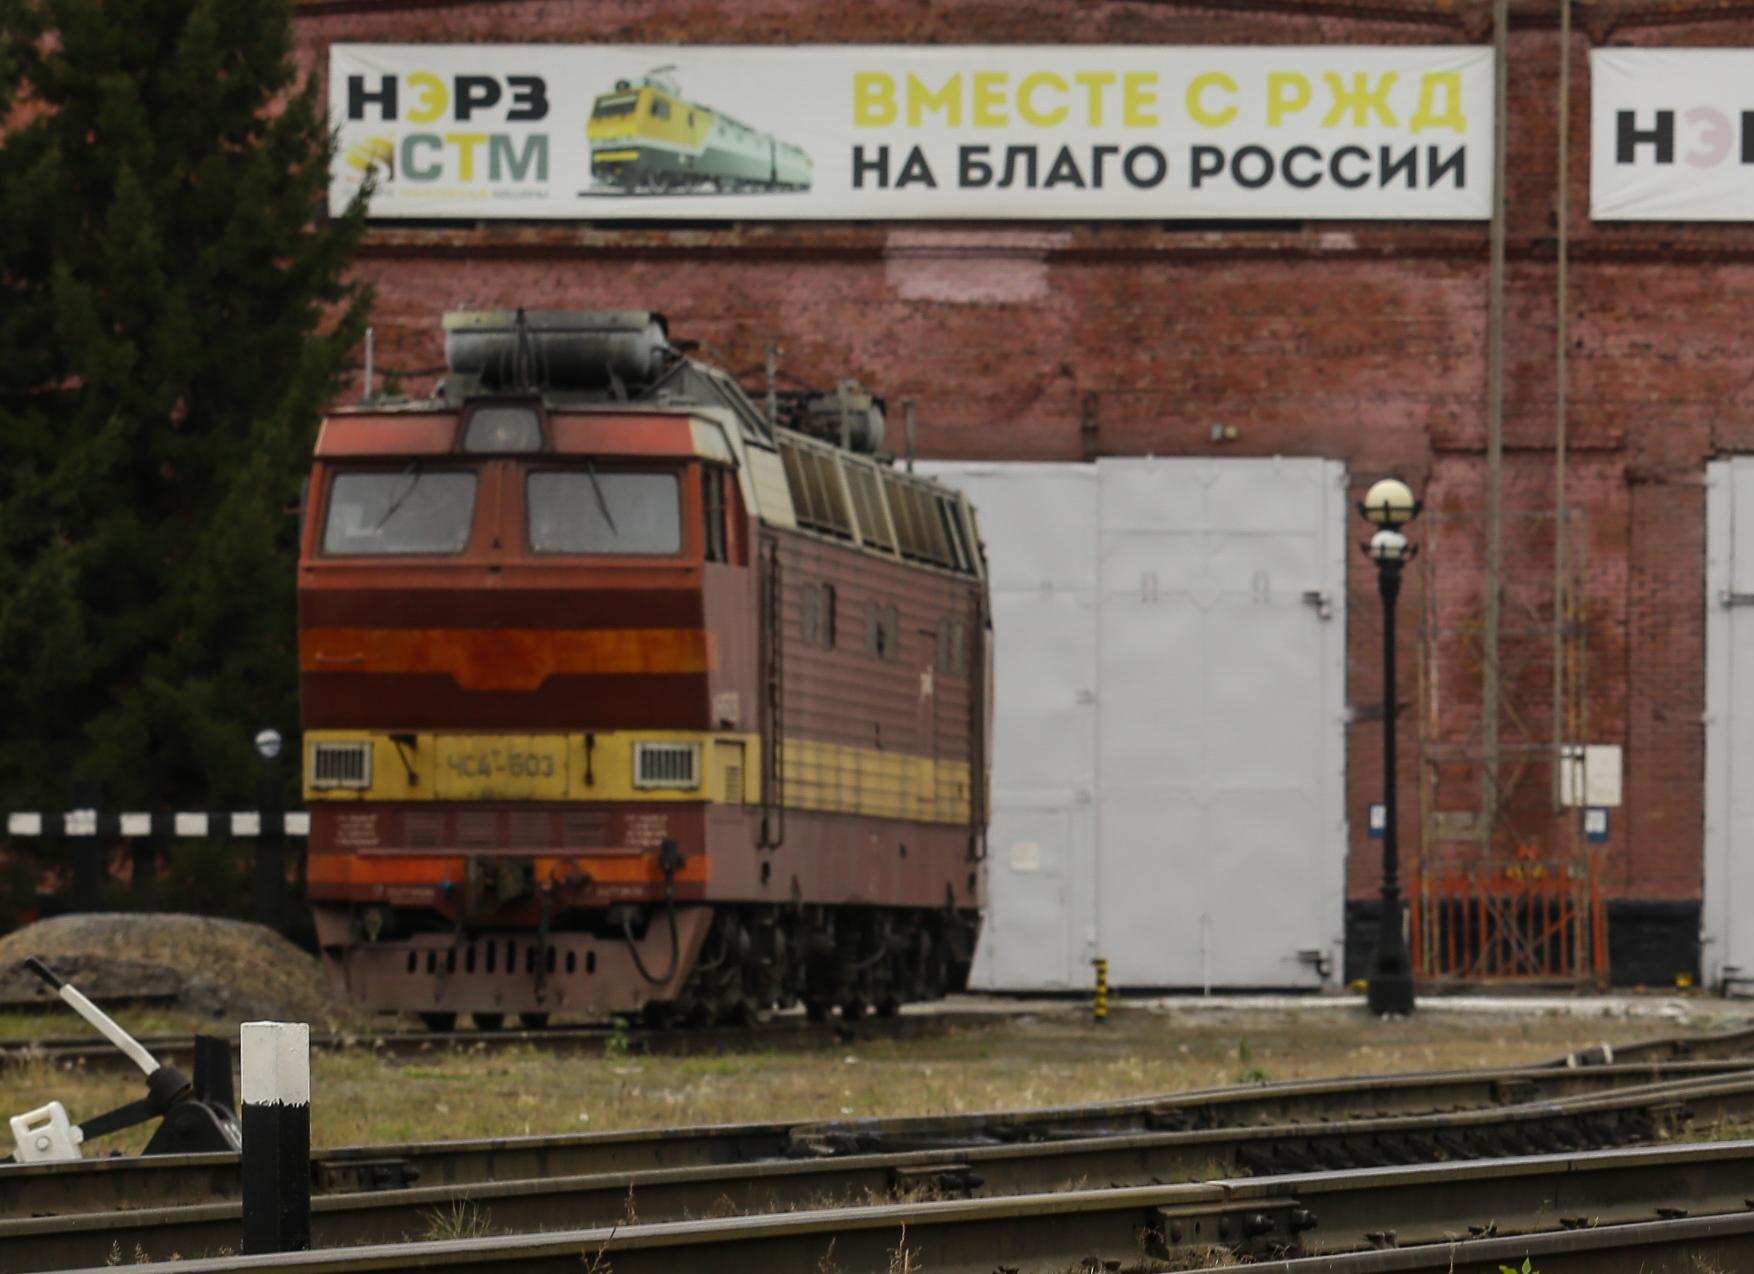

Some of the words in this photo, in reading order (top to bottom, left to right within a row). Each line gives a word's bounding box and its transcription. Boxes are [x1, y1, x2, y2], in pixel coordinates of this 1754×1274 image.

[347, 71, 550, 123] НЭРЗ
[853, 71, 1159, 127] ВМЕСТЕ
[1184, 71, 1239, 128] С
[1266, 71, 1467, 133] РЖД
[401, 132, 548, 182] СТМ
[852, 144, 938, 189] НА
[957, 144, 1169, 189] БЛАГО
[1190, 144, 1467, 190] РОССИИ
